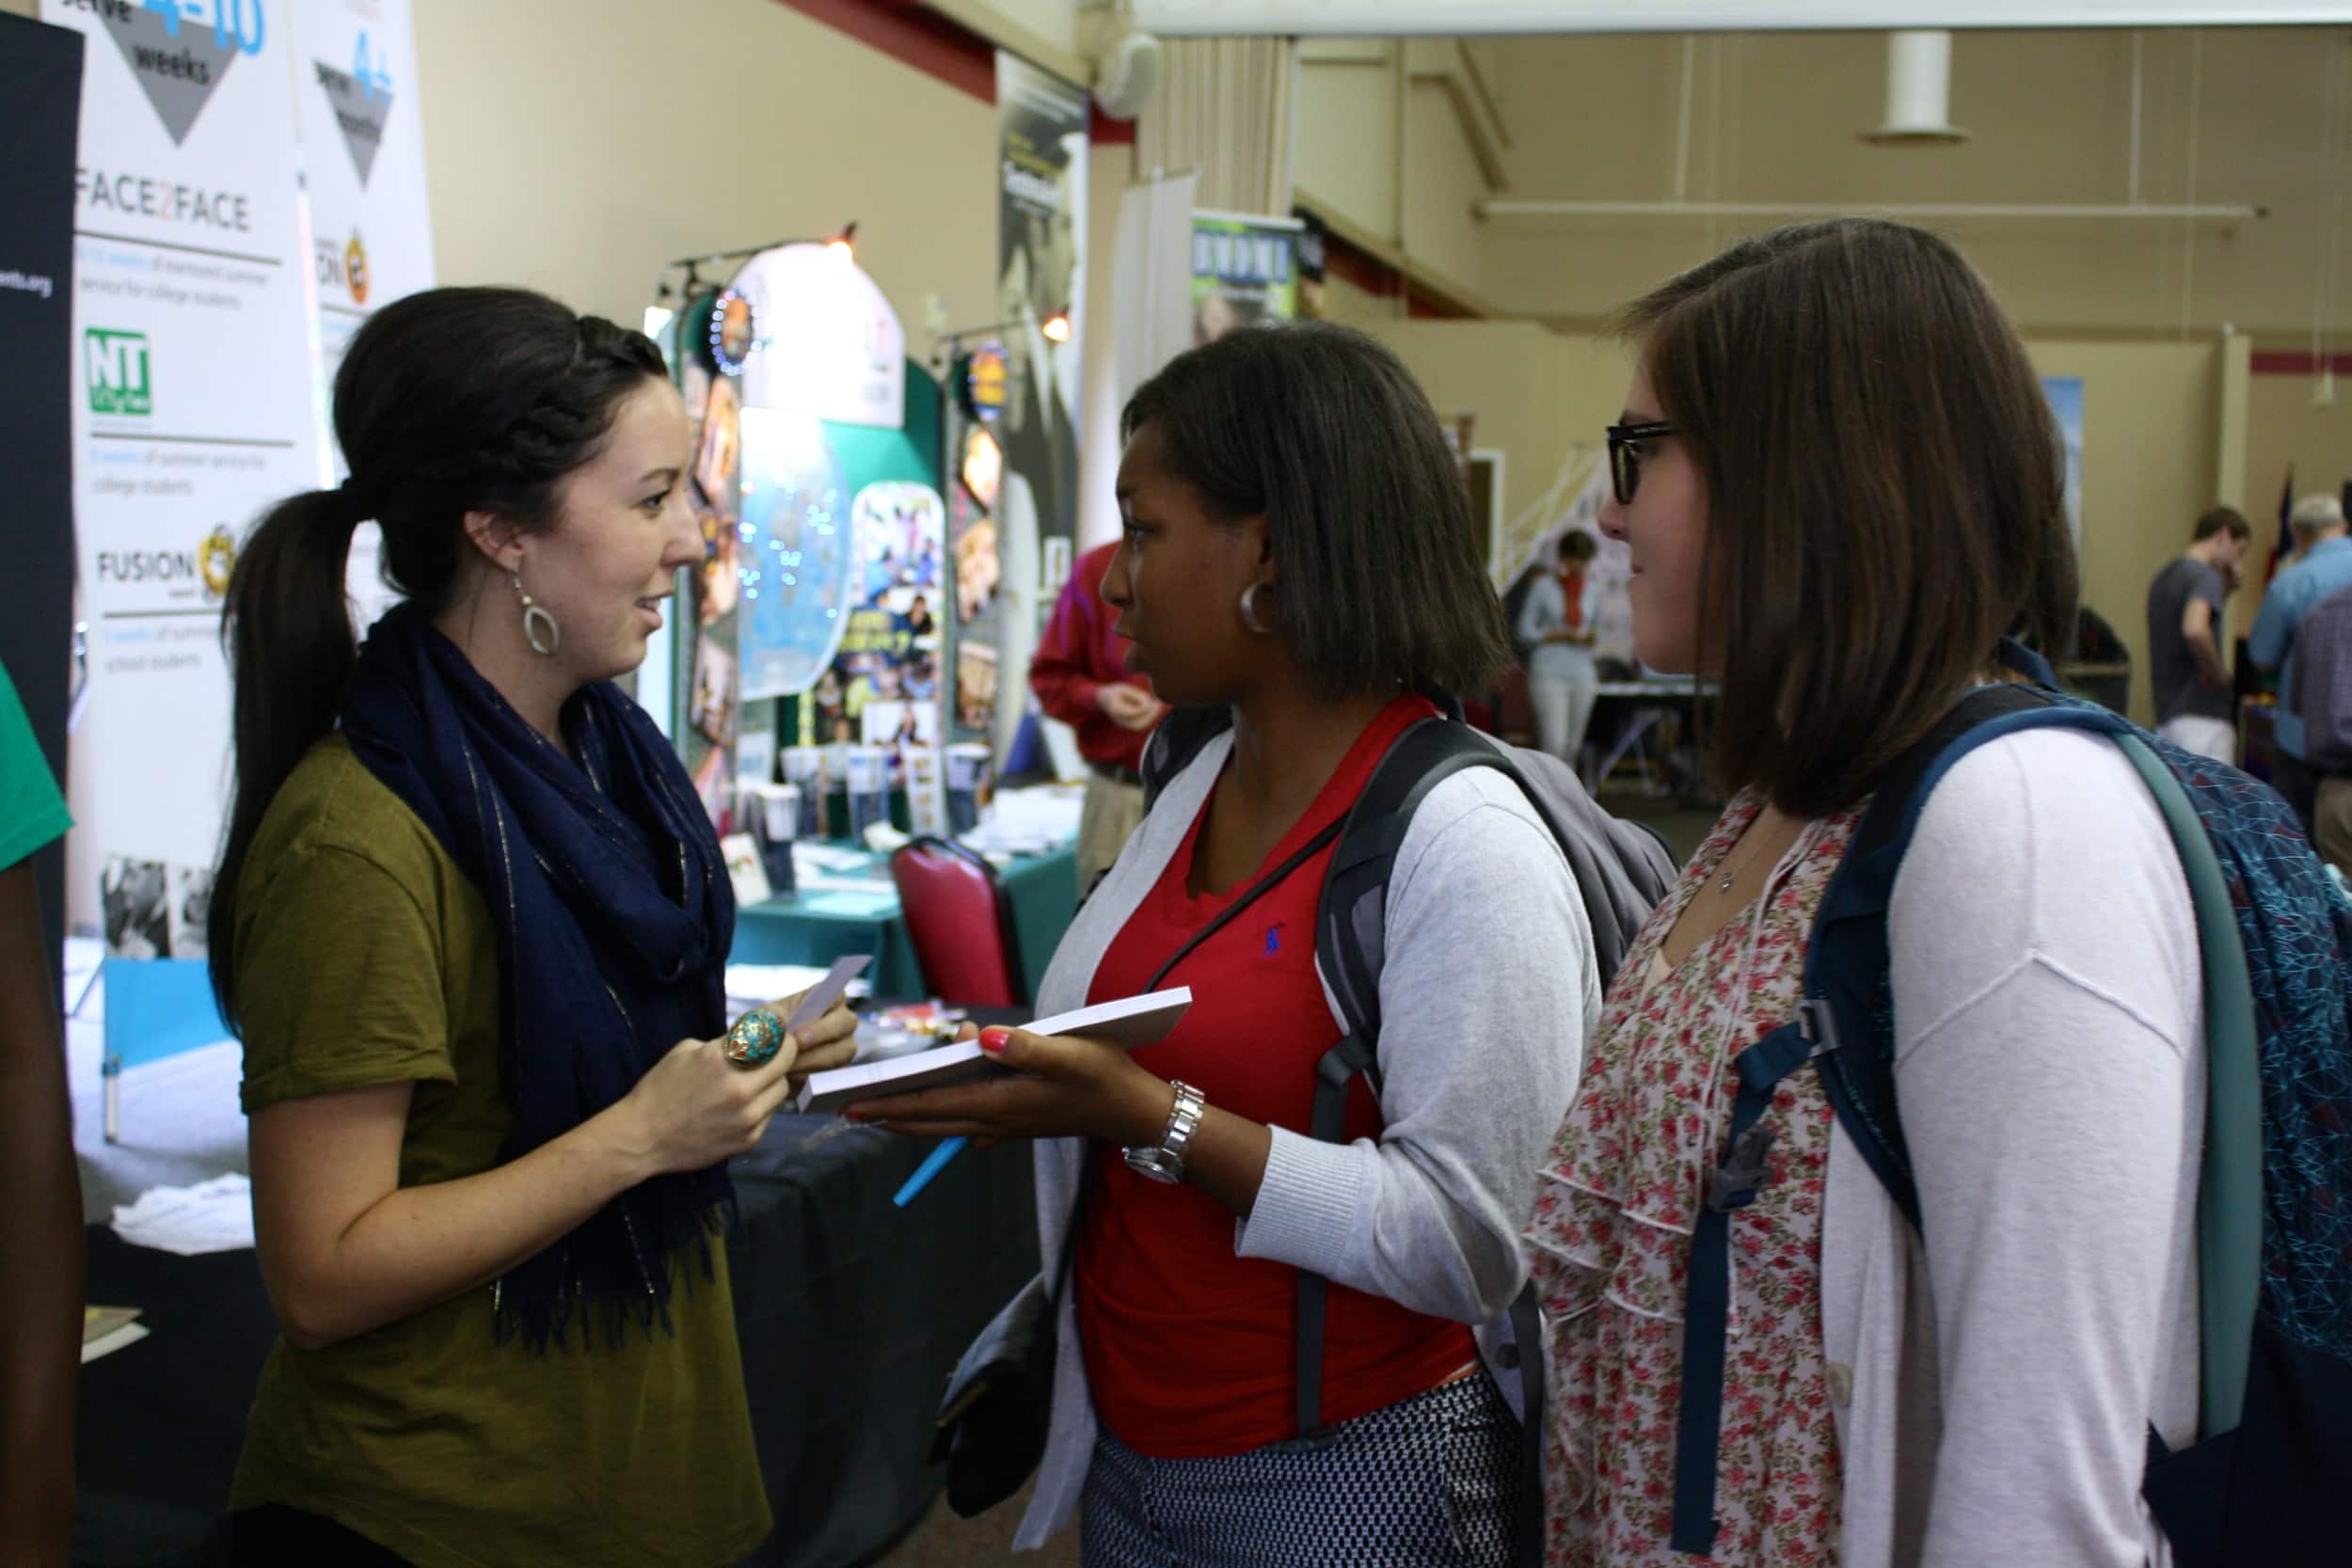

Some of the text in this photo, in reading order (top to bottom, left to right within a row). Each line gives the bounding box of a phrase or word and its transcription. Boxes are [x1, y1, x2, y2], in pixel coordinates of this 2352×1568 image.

[134, 46, 211, 87] weeks
[75, 166, 252, 232] FACE2FACE
[97, 551, 194, 581] FUSION
